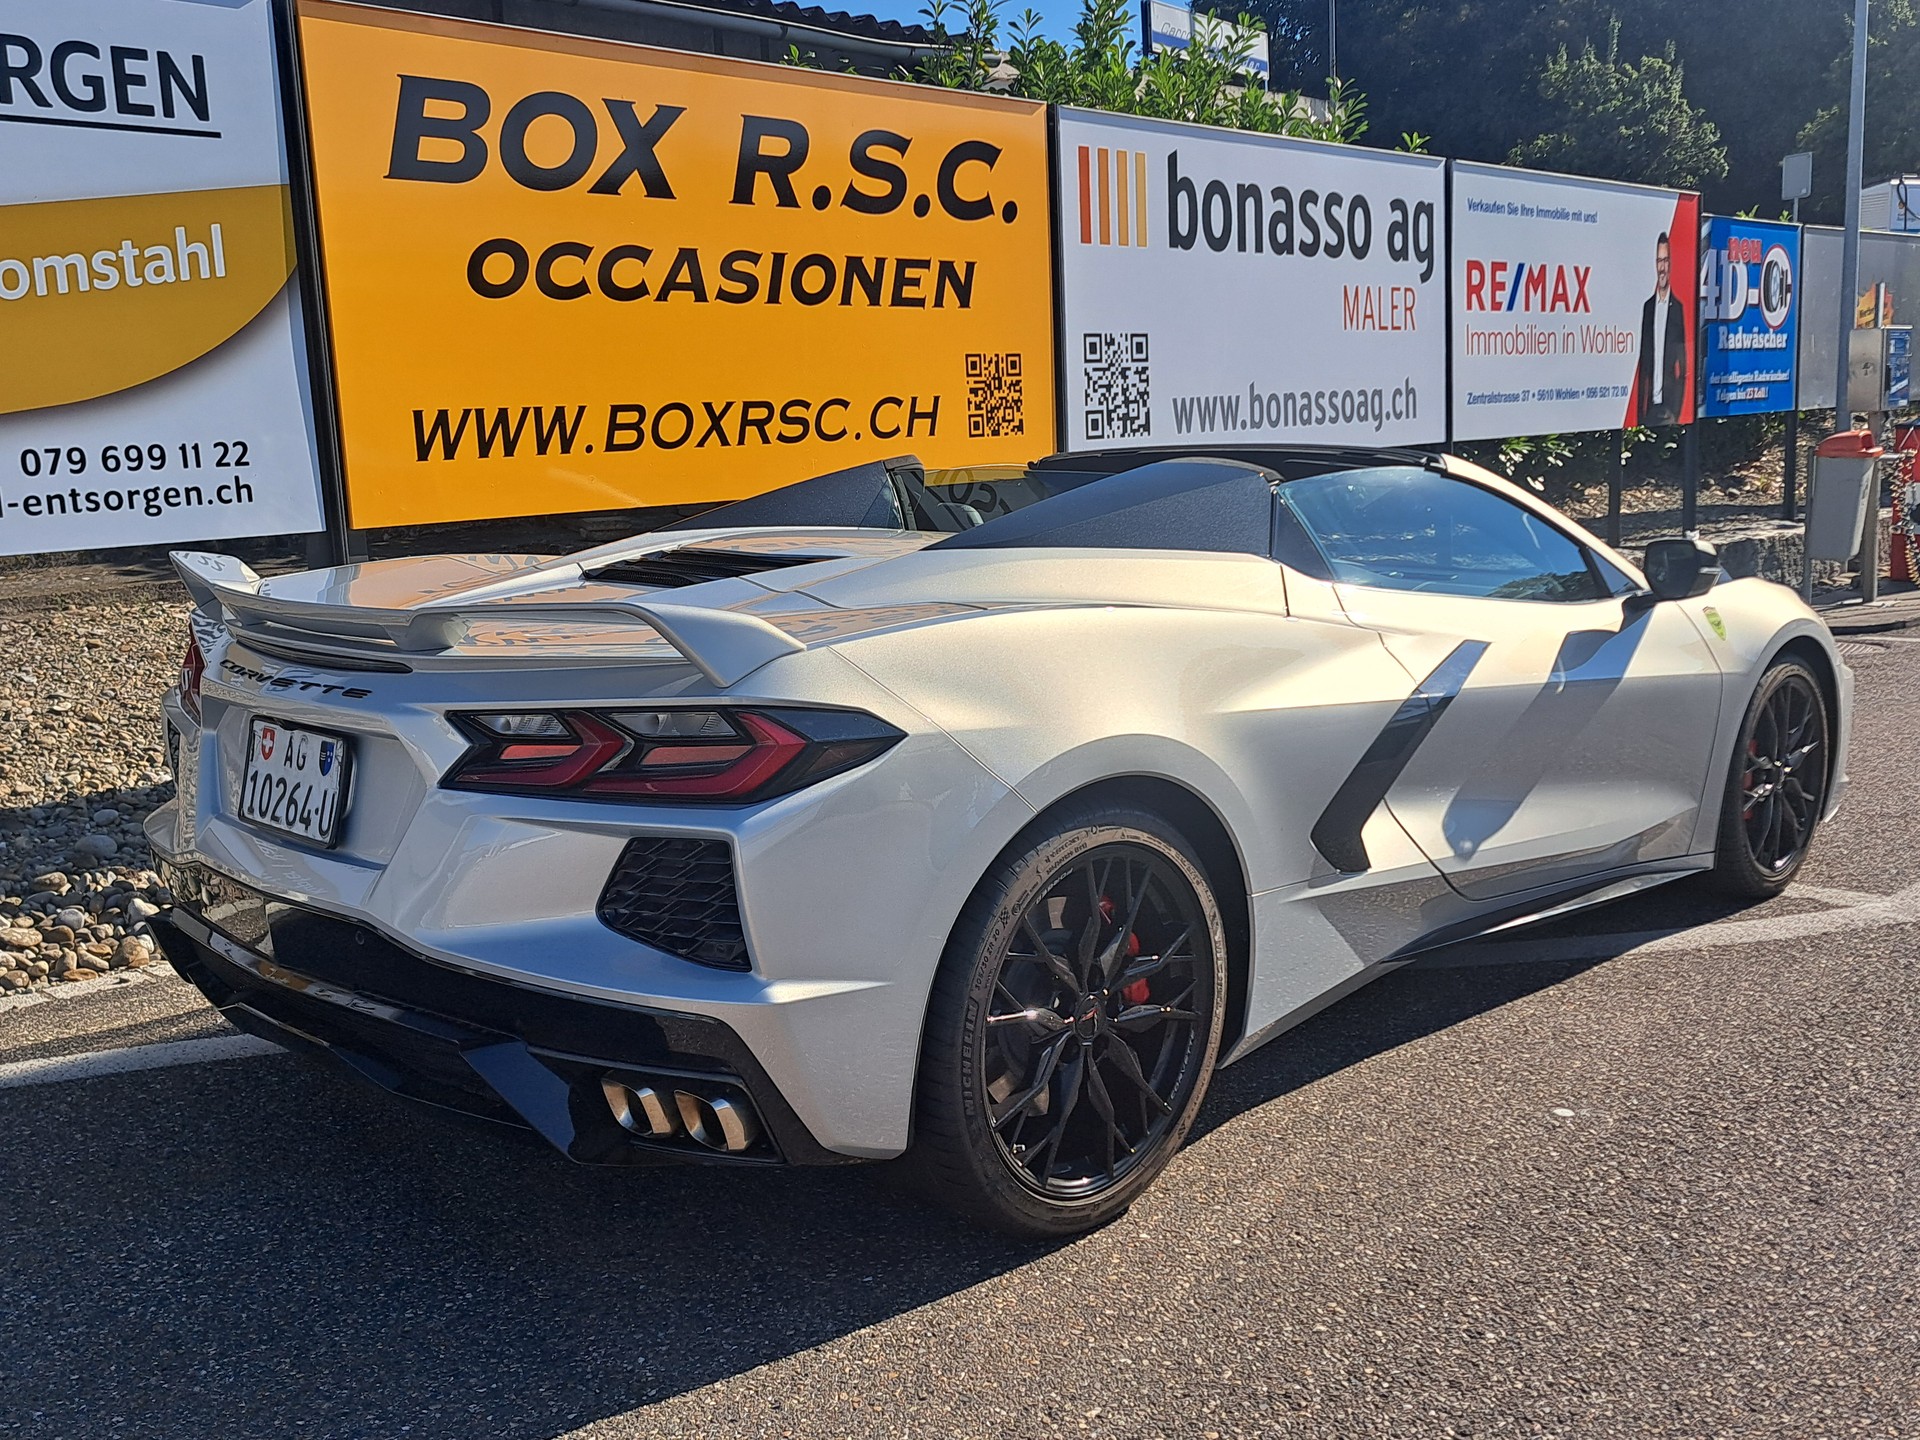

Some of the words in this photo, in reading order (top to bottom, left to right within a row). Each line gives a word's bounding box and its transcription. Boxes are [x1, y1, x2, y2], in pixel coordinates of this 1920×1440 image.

[384, 73, 688, 200] BOX
[729, 113, 1019, 224] R.S.C.
[1167, 149, 1372, 260] bonasso
[1387, 197, 1434, 284] ag
[1467, 197, 1505, 215] Verkaufen
[1507, 202, 1519, 216] Sie
[1520, 203, 1535, 218] Ihre
[1536, 205, 1570, 221] Immobilie
[1571, 209, 1582, 222] mit
[1583, 211, 1597, 223] uns!
[1728, 237, 1762, 263] neu
[466, 237, 977, 310] OCCASIONEN
[1466, 260, 1592, 313] RE/MAX
[1342, 285, 1416, 331] MALER
[1466, 323, 1557, 356] Immobilien
[1562, 325, 1576, 354] in
[1580, 325, 1635, 354] Wohlen
[1718, 325, 1788, 350] Radwäscher
[1172, 376, 1417, 434] www.bonassoag.ch
[1467, 391, 1520, 405] Zentralstrasse
[1555, 387, 1580, 400] Wohlen
[412, 395, 941, 463] WWW.BOXRSC.CH
[21, 447, 86, 476] 079
[101, 444, 167, 473] 699
[179, 442, 201, 469] 11
[213, 441, 251, 467] 22
[219, 659, 372, 698] CORVETTE
[284, 732, 308, 771] AG
[962, 1002, 979, 1116] MICHELIN
